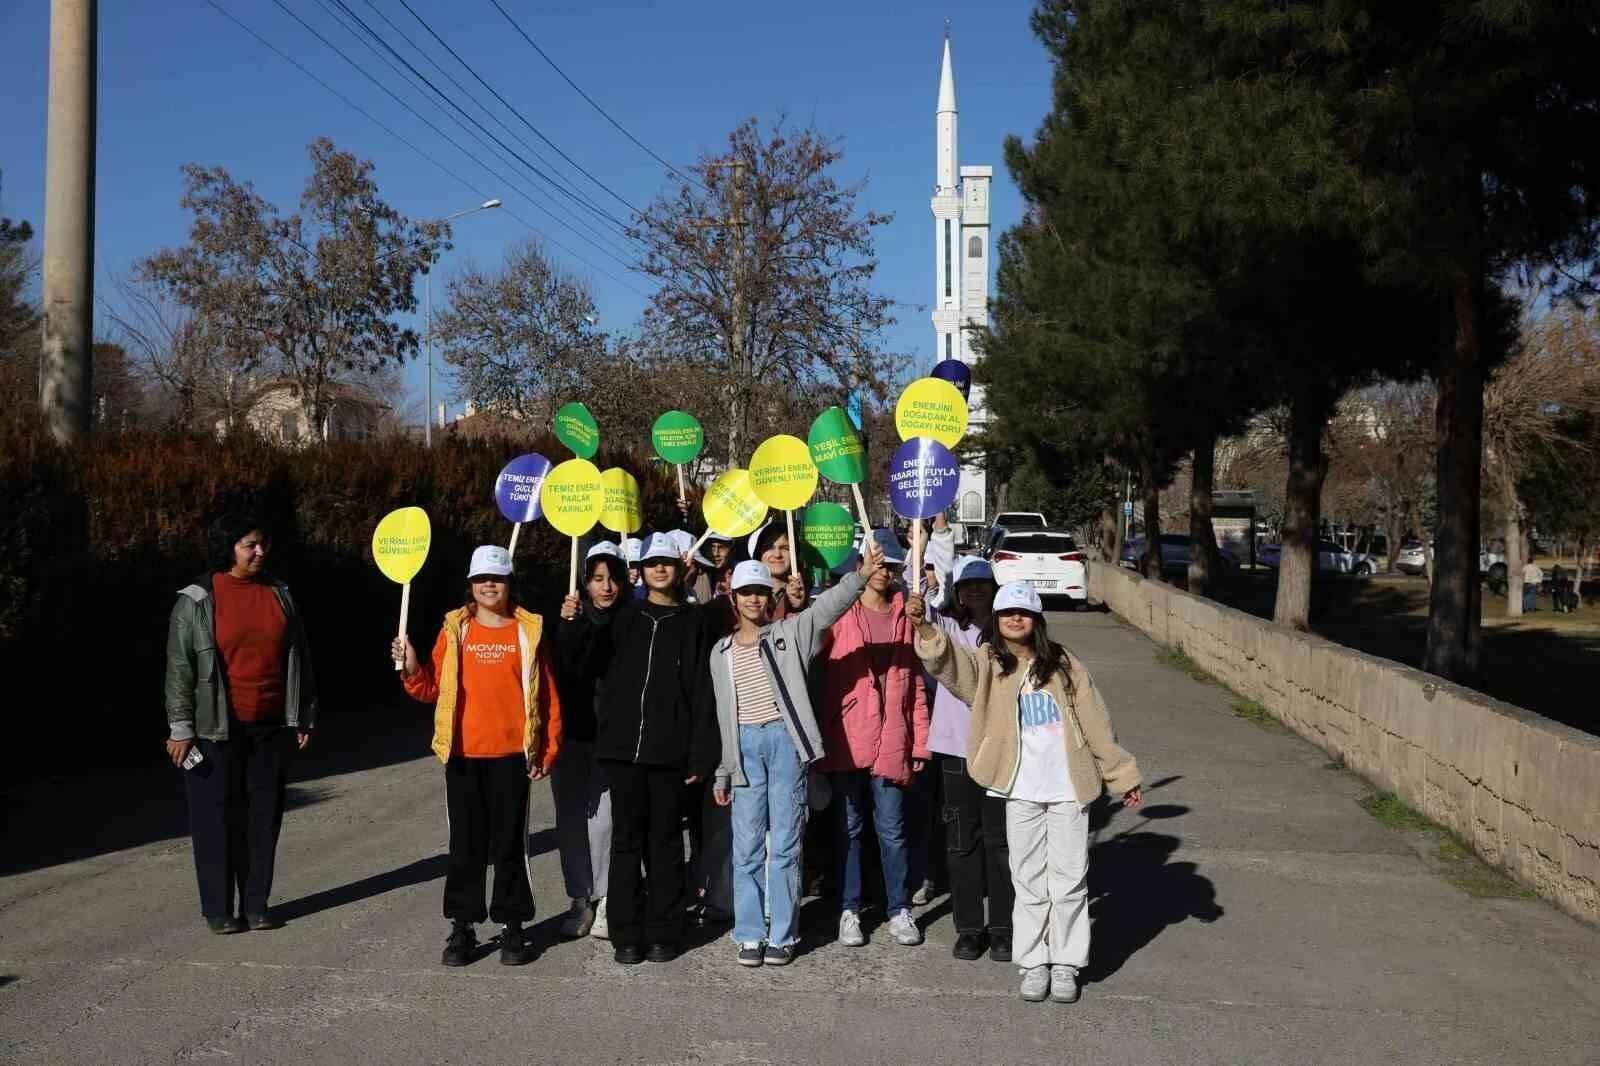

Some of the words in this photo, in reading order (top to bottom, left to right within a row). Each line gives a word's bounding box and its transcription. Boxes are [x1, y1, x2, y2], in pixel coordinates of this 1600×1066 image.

[948, 415, 961, 424] AL
[935, 423, 961, 434] KORU
[466, 643, 517, 653] MOVING
[475, 652, 505, 660] NOW!
